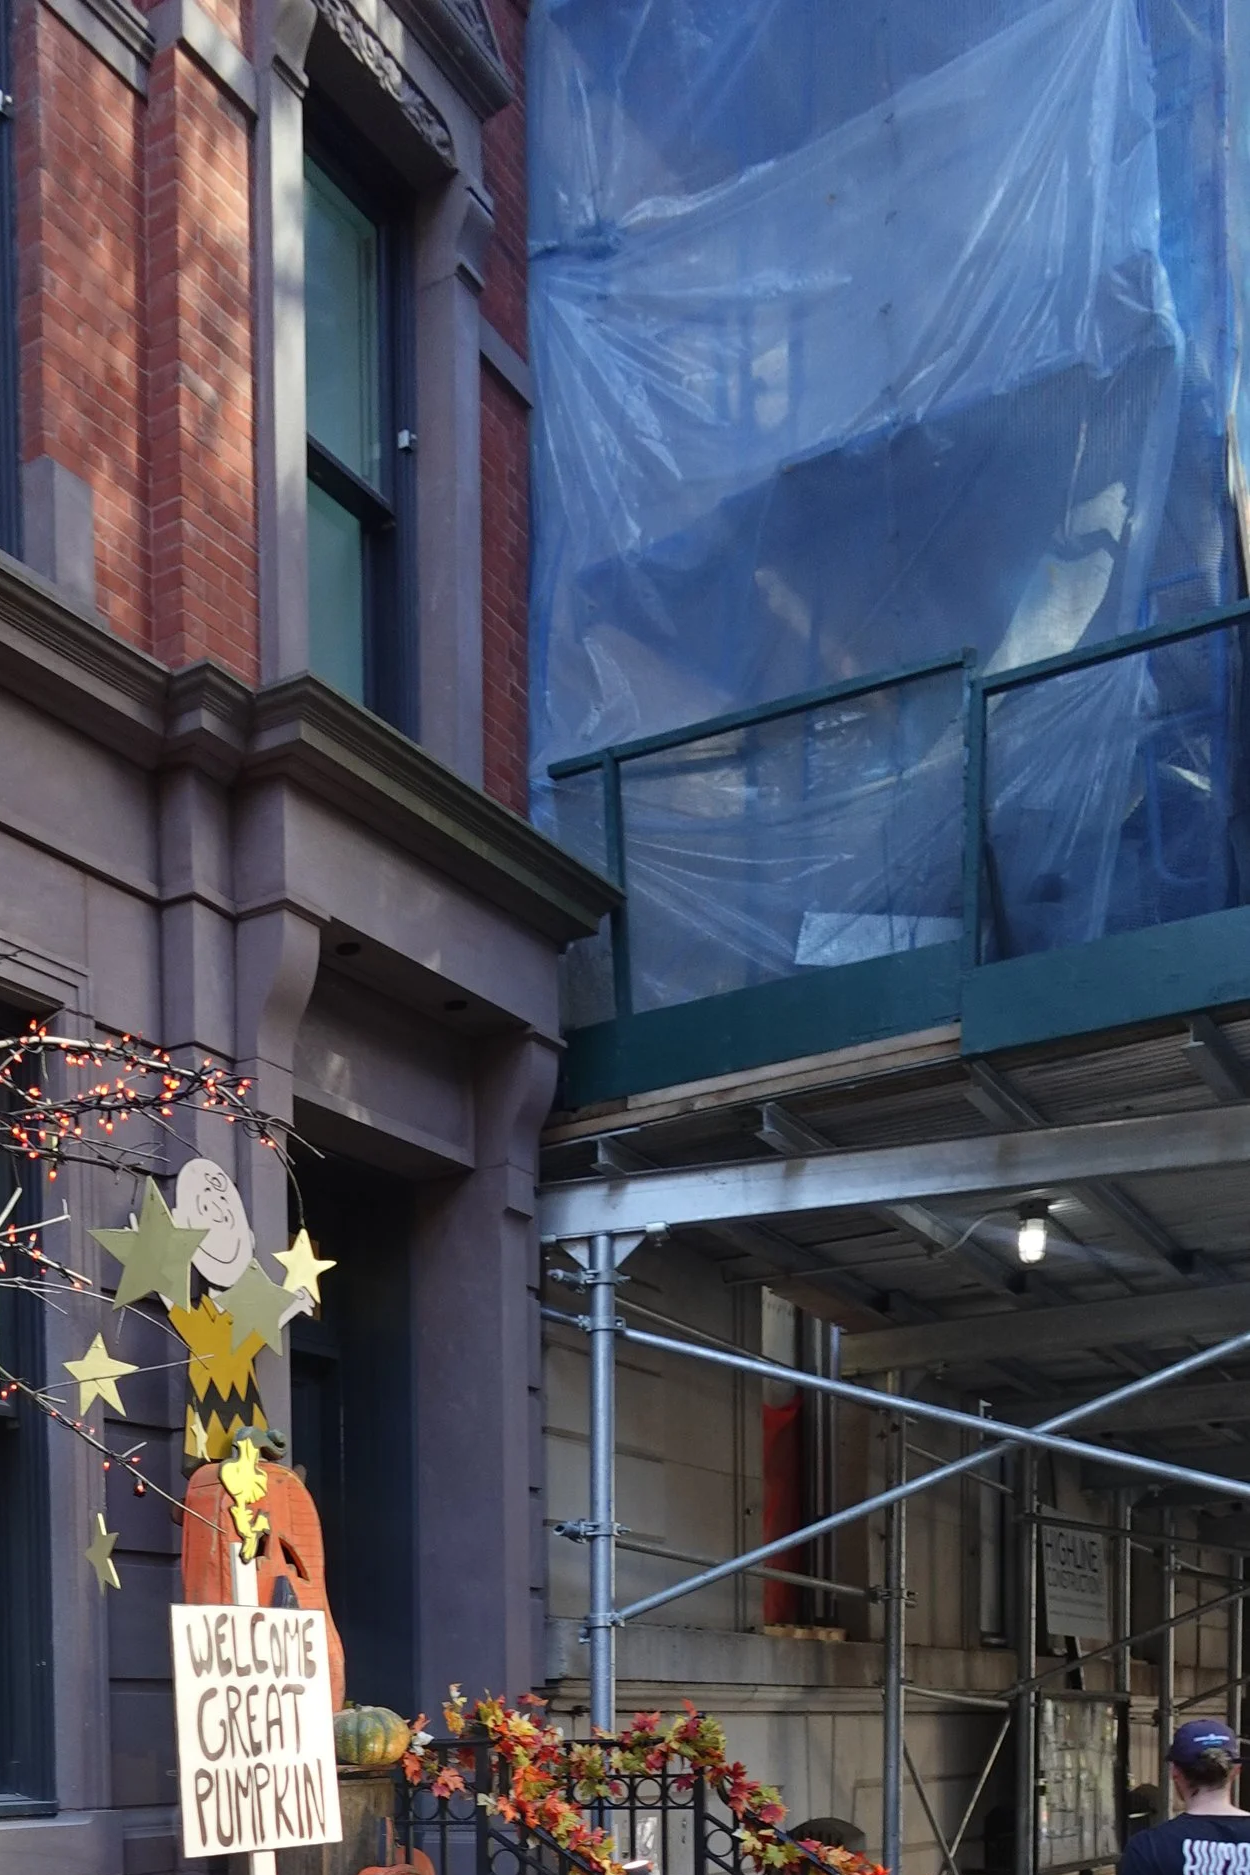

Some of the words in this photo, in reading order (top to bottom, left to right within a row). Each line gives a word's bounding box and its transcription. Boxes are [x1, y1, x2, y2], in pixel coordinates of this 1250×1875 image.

[1045, 1528, 1098, 1573] HIGHLINE
[186, 1612, 316, 1679] WELCOME
[197, 1683, 305, 1761] GREAT
[194, 1758, 326, 1847] PUMPKIN
